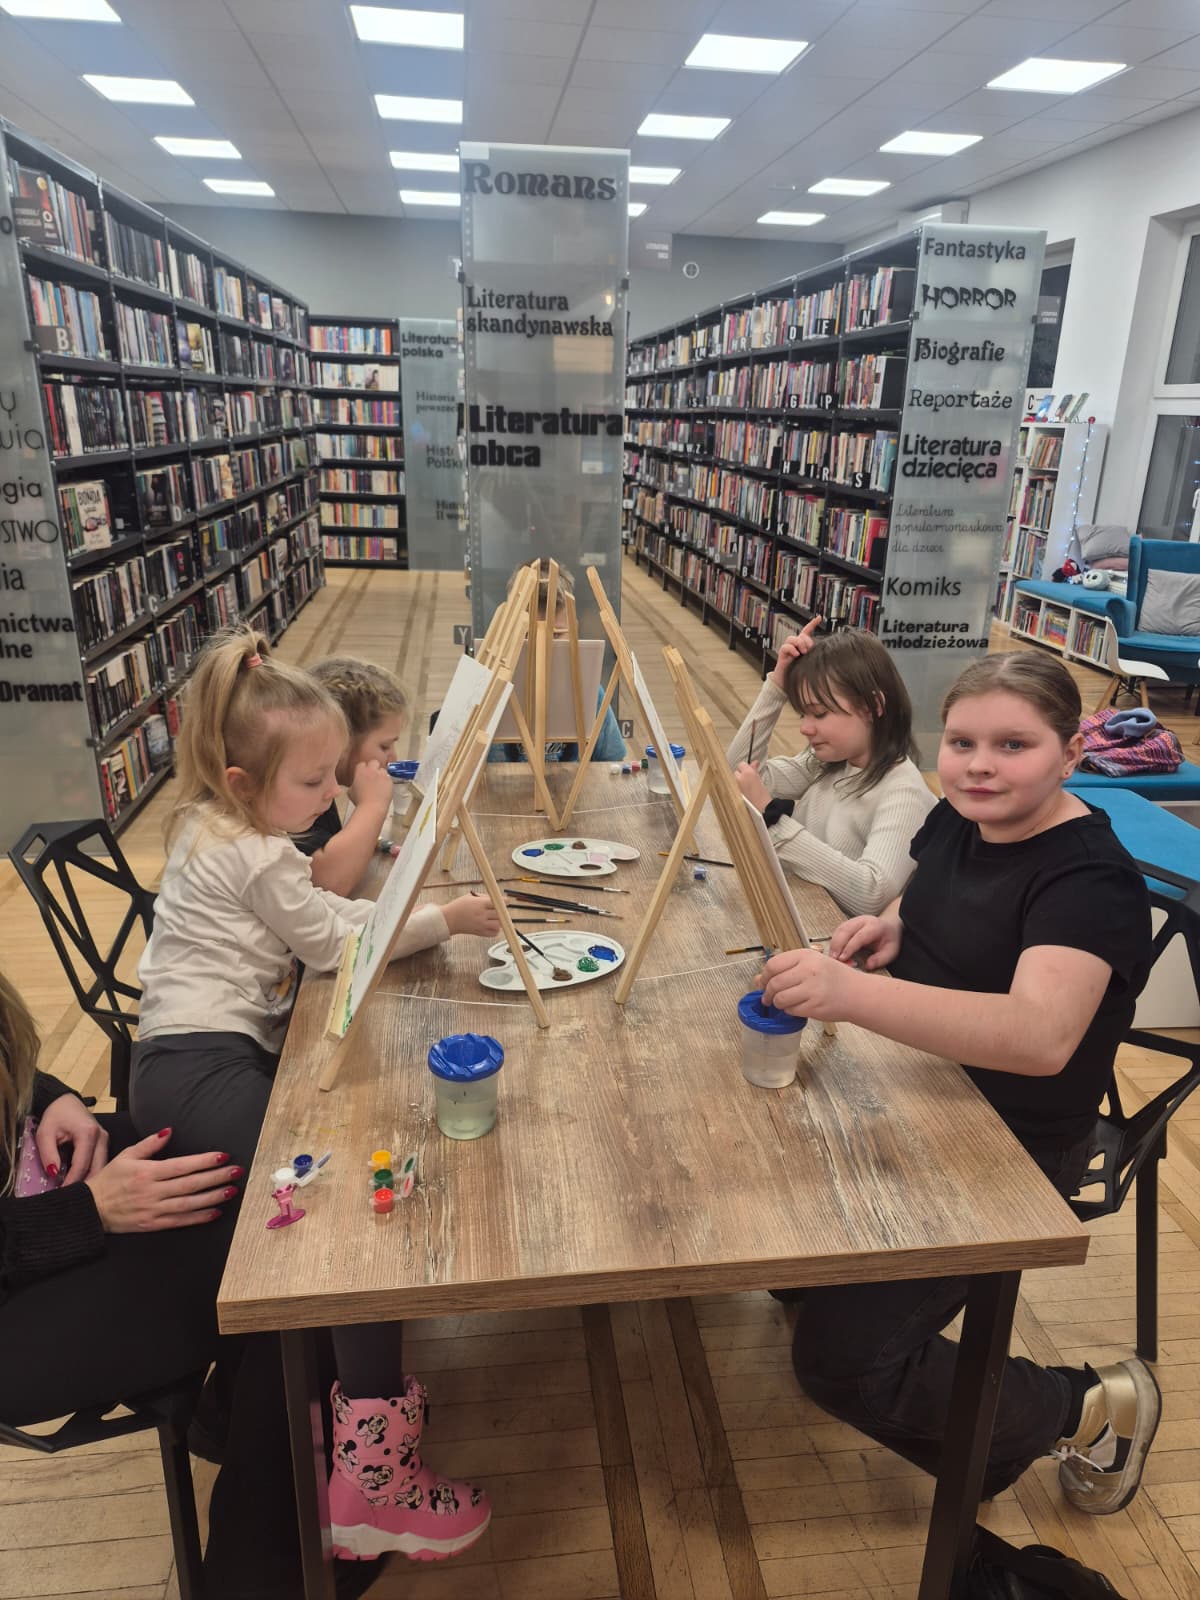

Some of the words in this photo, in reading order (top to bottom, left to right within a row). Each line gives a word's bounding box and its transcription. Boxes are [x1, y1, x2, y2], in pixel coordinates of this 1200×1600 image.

[463, 161, 617, 201] Romans
[924, 237, 1026, 263] Fantastyka
[466, 286, 569, 311] Literatura
[921, 283, 1016, 310] HORROR
[466, 311, 614, 338] skandynawska
[862, 310, 870, 325] N
[56, 327, 70, 350] B
[914, 337, 1005, 365] Biografie
[908, 390, 1012, 412] Reportaże
[469, 405, 623, 436] Literatura
[470, 440, 541, 467] obca
[902, 434, 1002, 457] Literatura
[855, 472, 863, 488] S
[902, 457, 997, 483] dziecięca
[886, 576, 962, 596] Komiks
[882, 619, 969, 633] Literatura
[882, 634, 989, 649] młodzieżowa
[0, 681, 83, 702] Dramat
[622, 722, 631, 738] C
